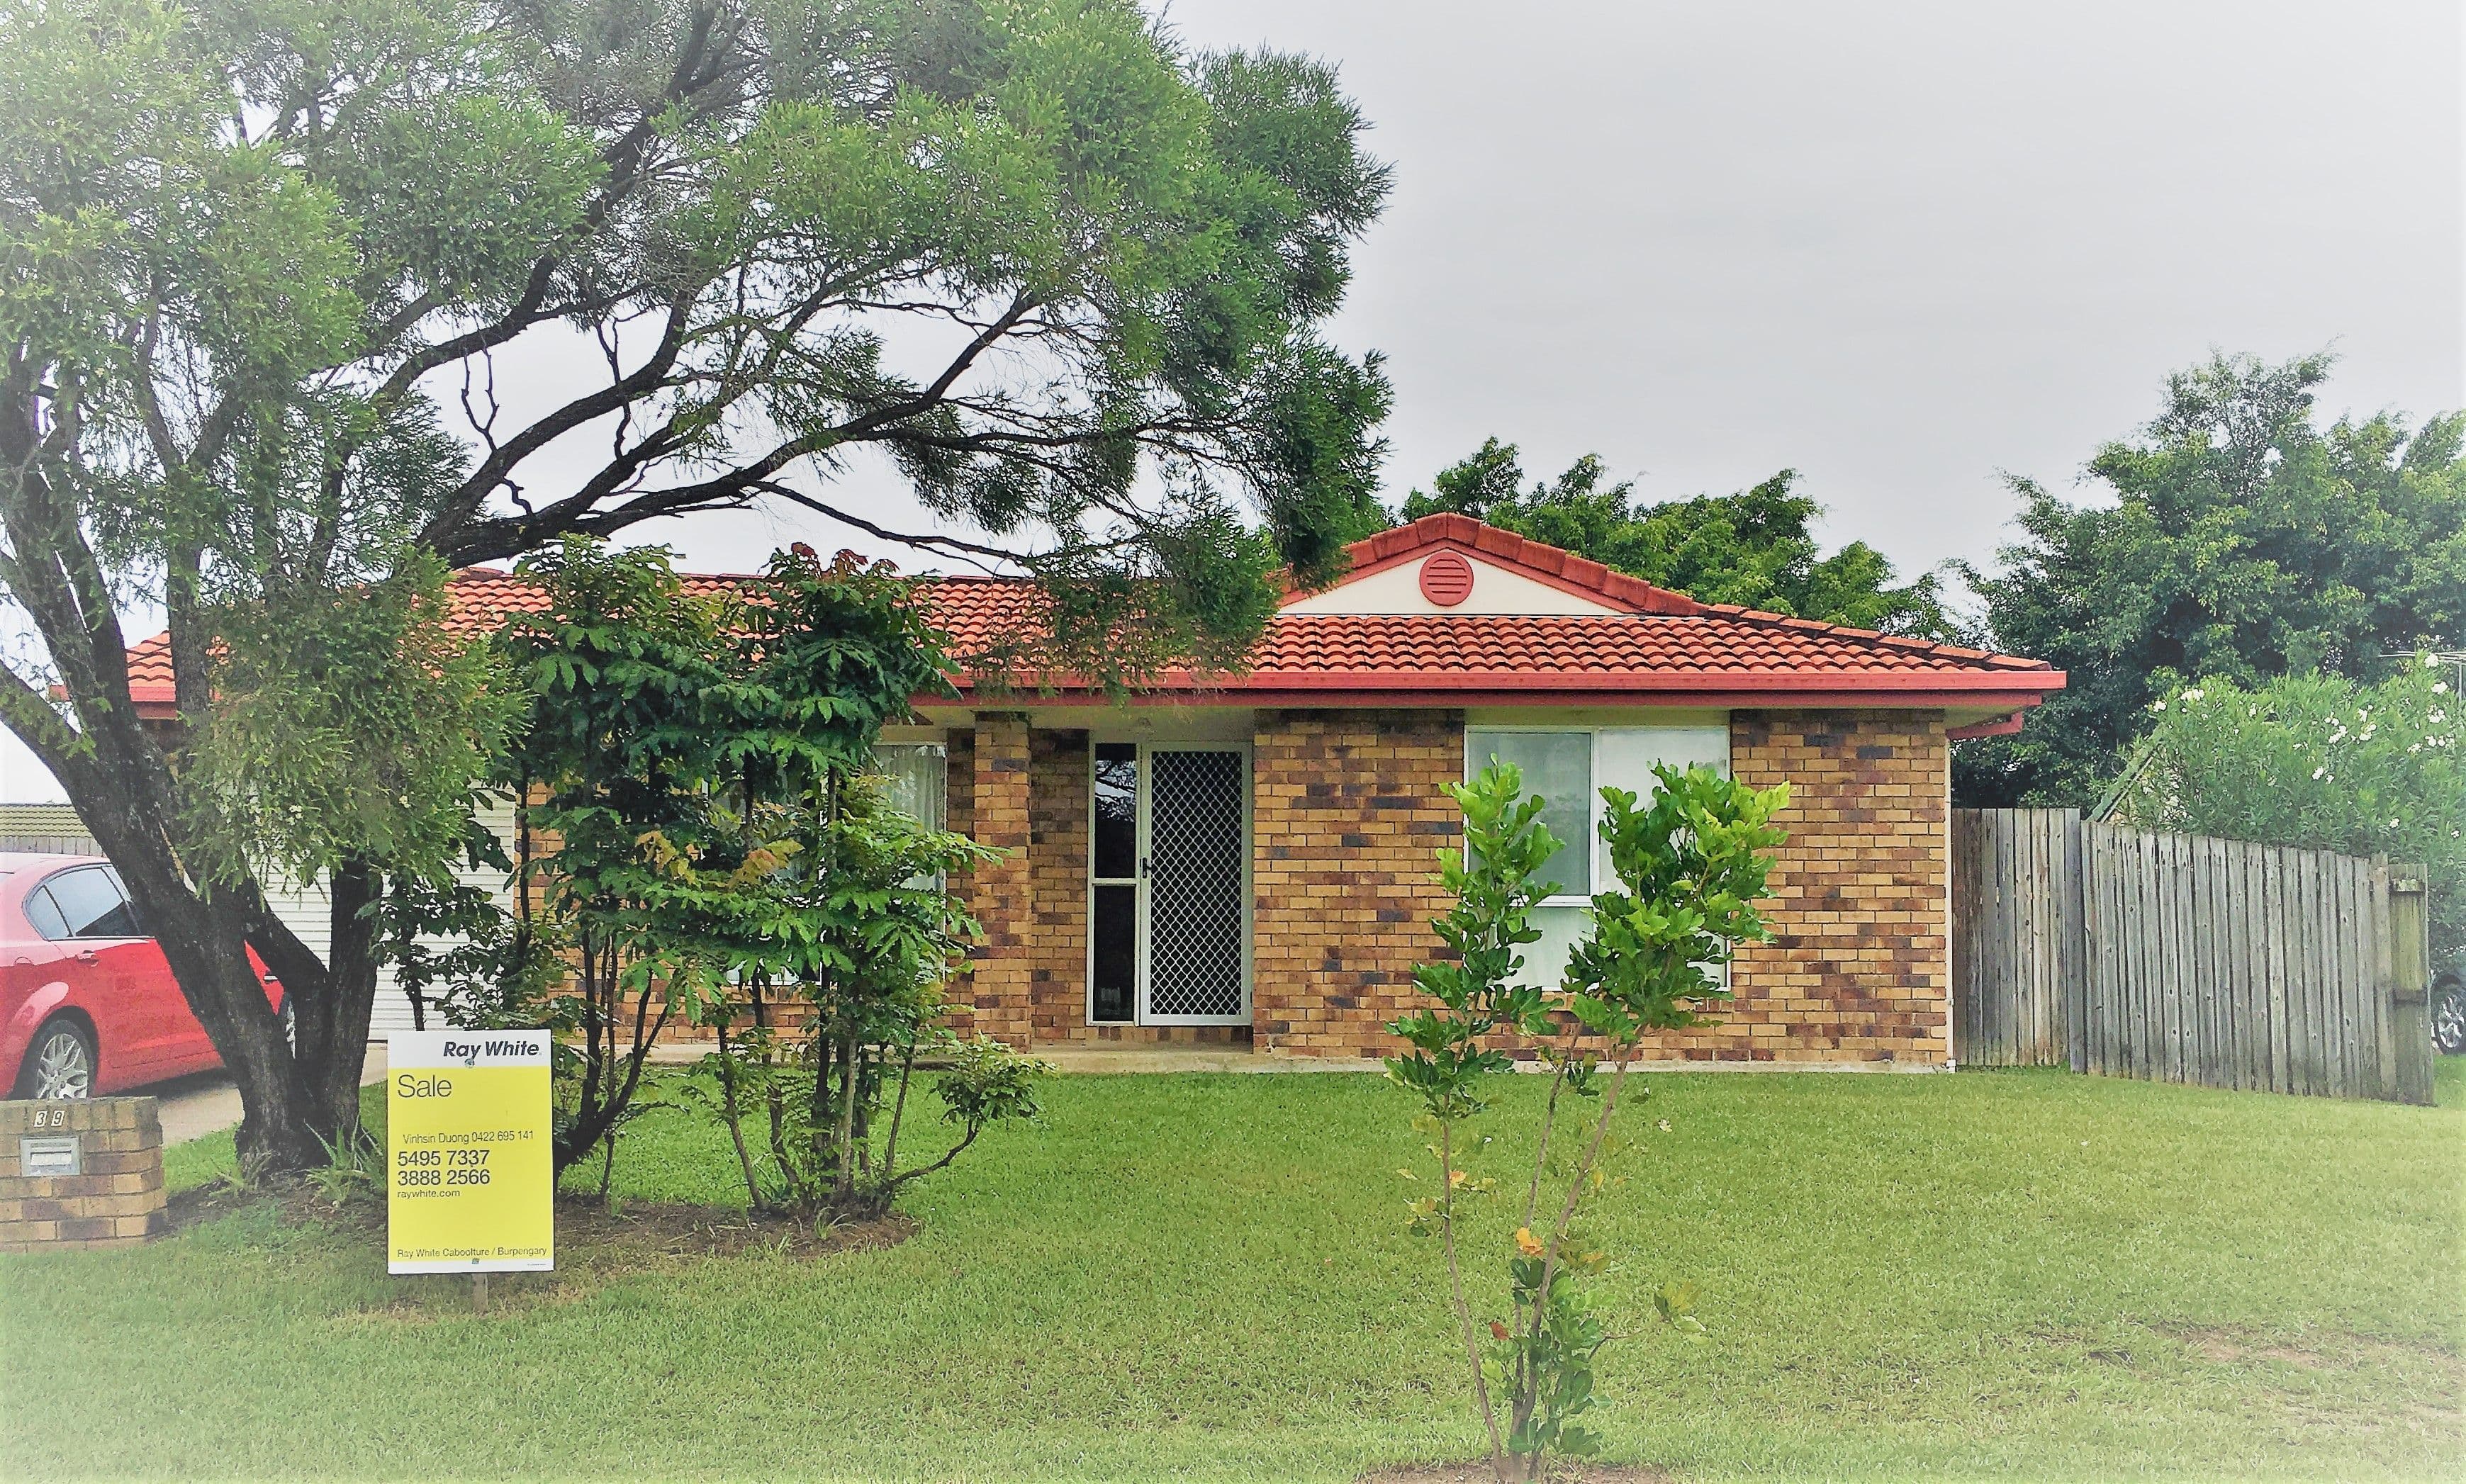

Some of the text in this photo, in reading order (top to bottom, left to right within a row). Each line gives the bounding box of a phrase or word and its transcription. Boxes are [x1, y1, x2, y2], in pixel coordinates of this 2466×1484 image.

[443, 1040, 539, 1060] Ray White
[398, 1074, 452, 1098] Sale
[36, 1111, 64, 1125] 39
[403, 1130, 534, 1145] Vinhsin Duong 0422 695 141
[398, 1150, 490, 1166] 5495 7337
[398, 1169, 490, 1186] 3888 2566
[397, 1189, 460, 1199] raywhite.com
[397, 1249, 414, 1259] Ray
[416, 1249, 439, 1257] White
[442, 1247, 490, 1257] Caboolture
[498, 1247, 547, 1256] Burpengary
